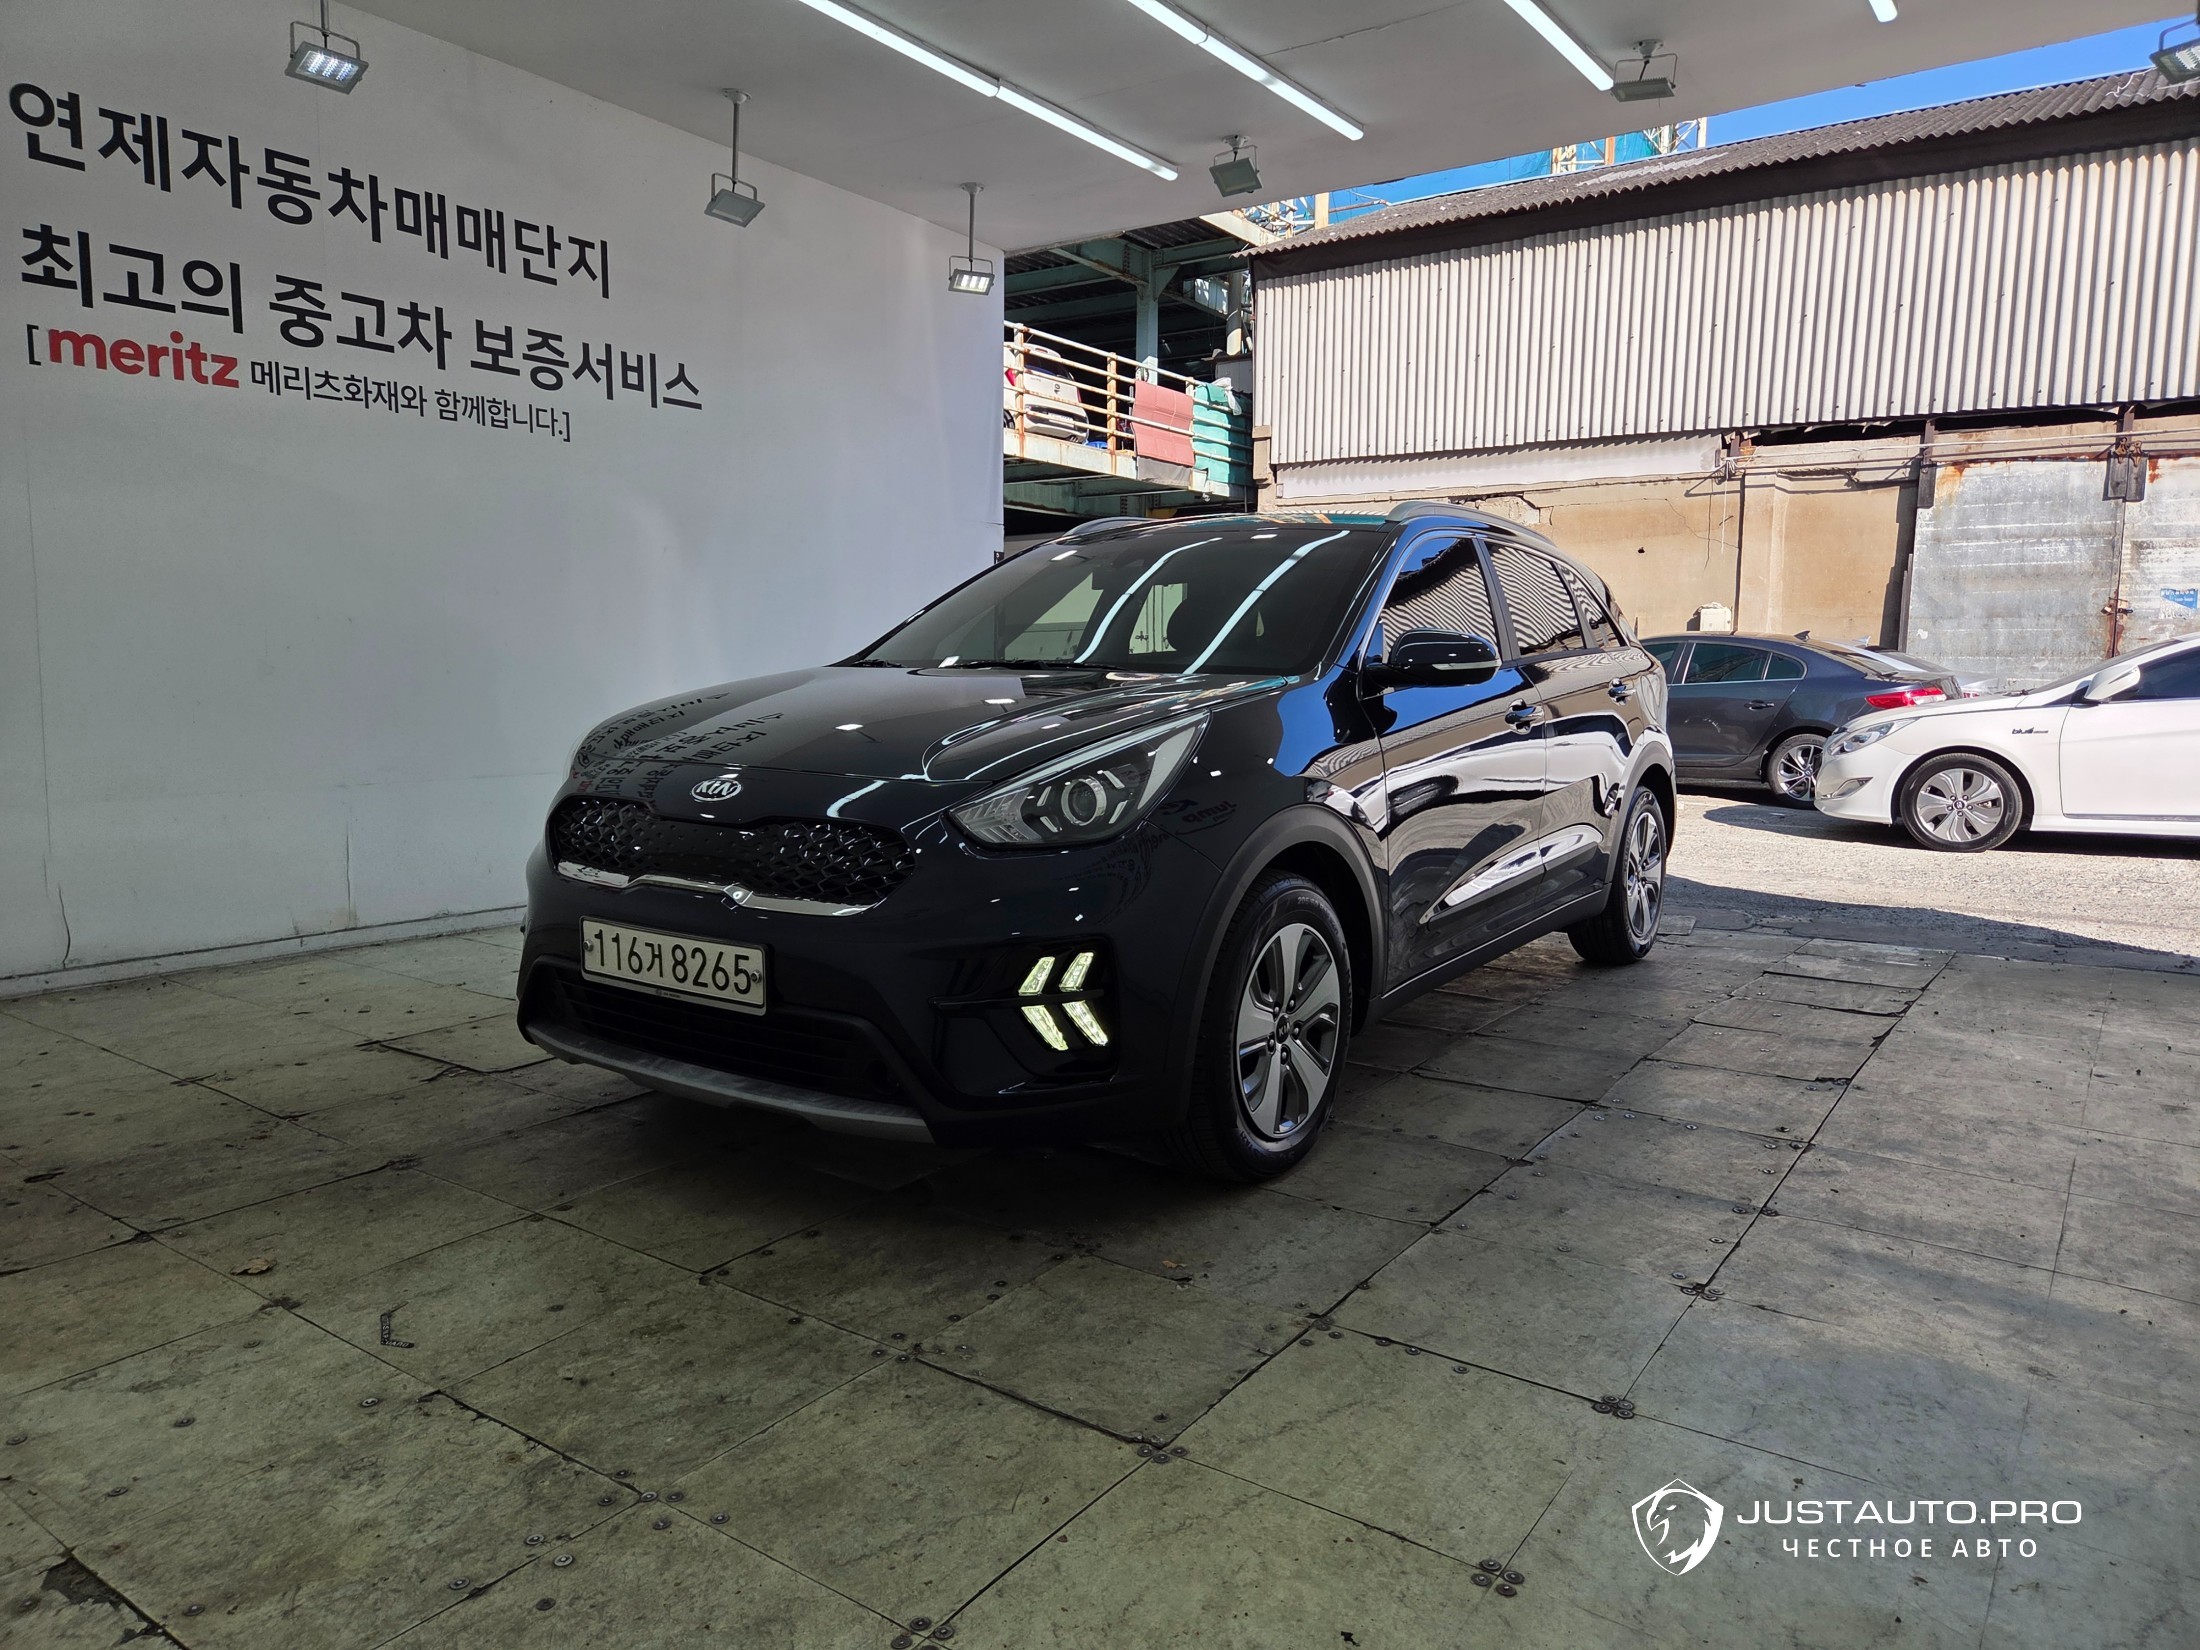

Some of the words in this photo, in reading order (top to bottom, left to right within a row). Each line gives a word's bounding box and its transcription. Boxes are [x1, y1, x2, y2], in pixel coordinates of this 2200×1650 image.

[9, 83, 611, 300] 연제자동차매매단지
[21, 223, 245, 335] 최고의
[268, 274, 453, 371] 중고차
[470, 319, 703, 410] 보증서비스
[250, 360, 428, 418] 메리츠화재와
[696, 780, 732, 796] KIA
[594, 929, 664, 978] 116거
[671, 943, 752, 995] 8265
[1278, 1022, 1290, 1038] KIA
